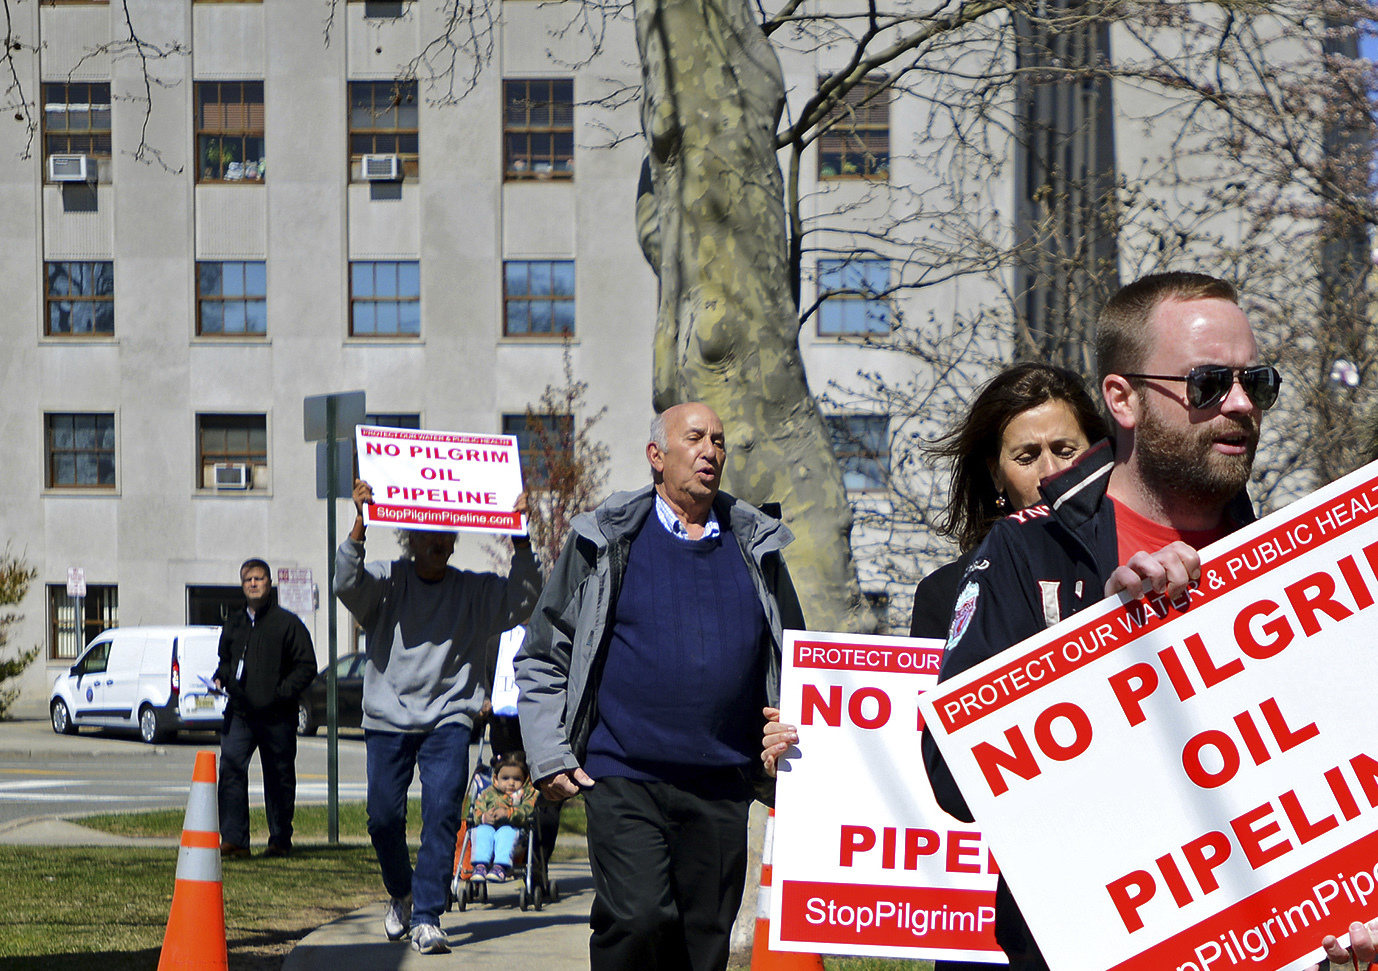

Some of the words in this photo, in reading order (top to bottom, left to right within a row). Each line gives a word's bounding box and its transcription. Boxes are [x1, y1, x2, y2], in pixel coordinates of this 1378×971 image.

[366, 442, 400, 457] NO
[410, 445, 509, 463] PILGRIM
[420, 467, 460, 482] OIL
[387, 485, 498, 505] PIPELINE
[377, 506, 514, 525] StopPilgrimPipeline.com
[944, 655, 1059, 725] PROTECT
[1062, 622, 1117, 663] OUR
[1117, 579, 1205, 633] WATER
[1206, 569, 1228, 590] &
[1226, 523, 1314, 577] PUBLIC
[799, 647, 892, 668] PROTECT
[897, 651, 940, 670] OUR
[800, 683, 892, 730] NO
[971, 702, 1093, 798] NO
[1183, 696, 1321, 790] OIL
